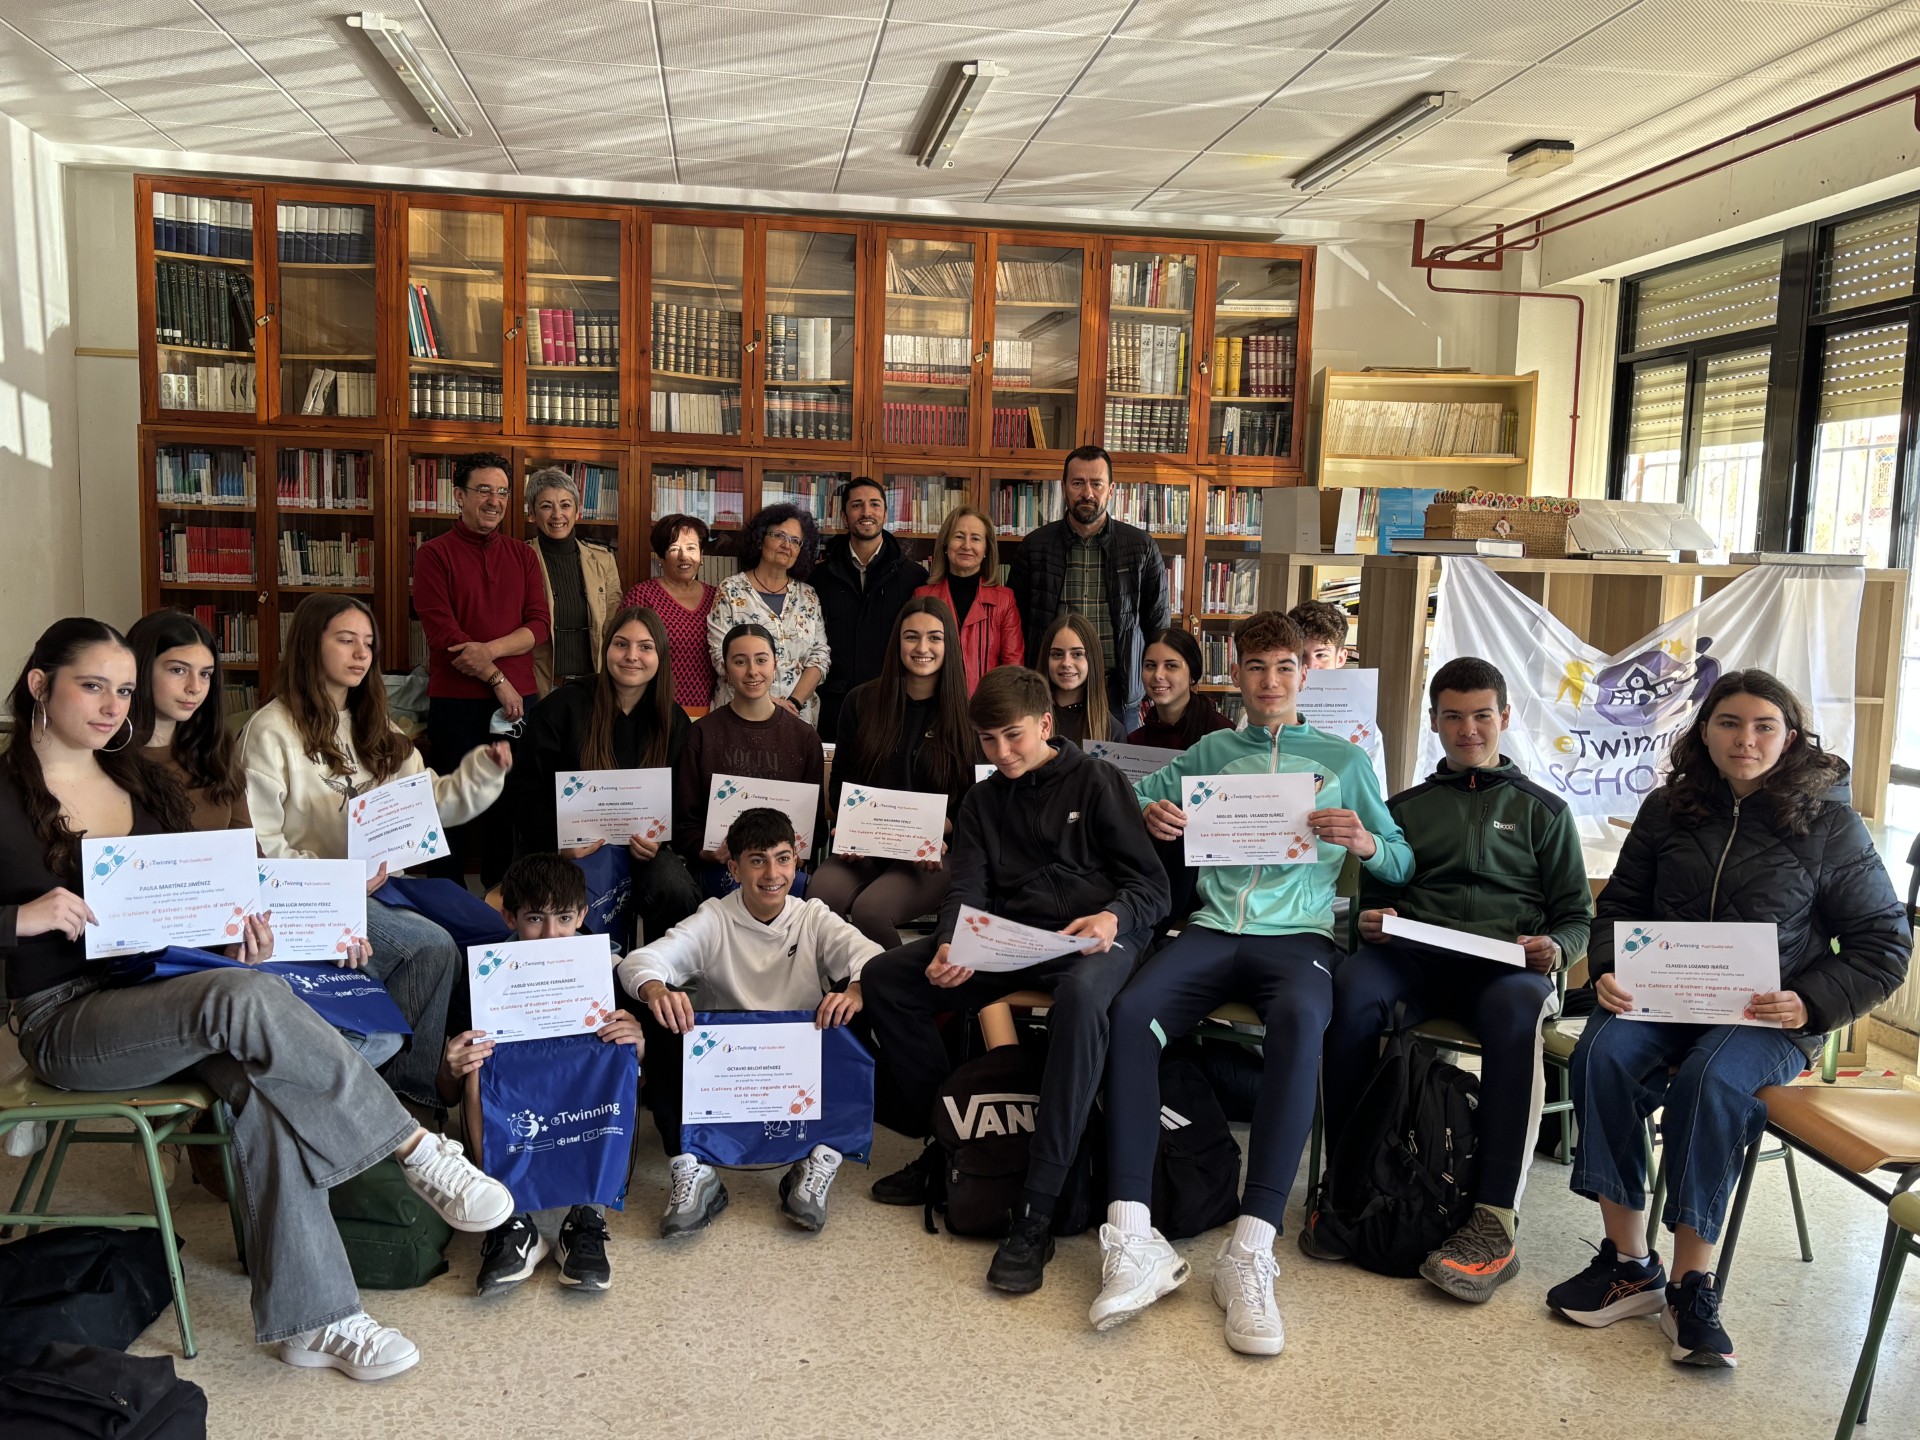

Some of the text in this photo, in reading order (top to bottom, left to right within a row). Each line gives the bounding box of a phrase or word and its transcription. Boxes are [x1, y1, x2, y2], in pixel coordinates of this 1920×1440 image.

[1549, 763, 1659, 796] SCHO
[159, 882, 187, 890] MARTÍNEZ
[316, 973, 371, 982] eTwinning
[551, 1103, 620, 1125] eTwinning
[942, 1093, 1040, 1140] VAN
